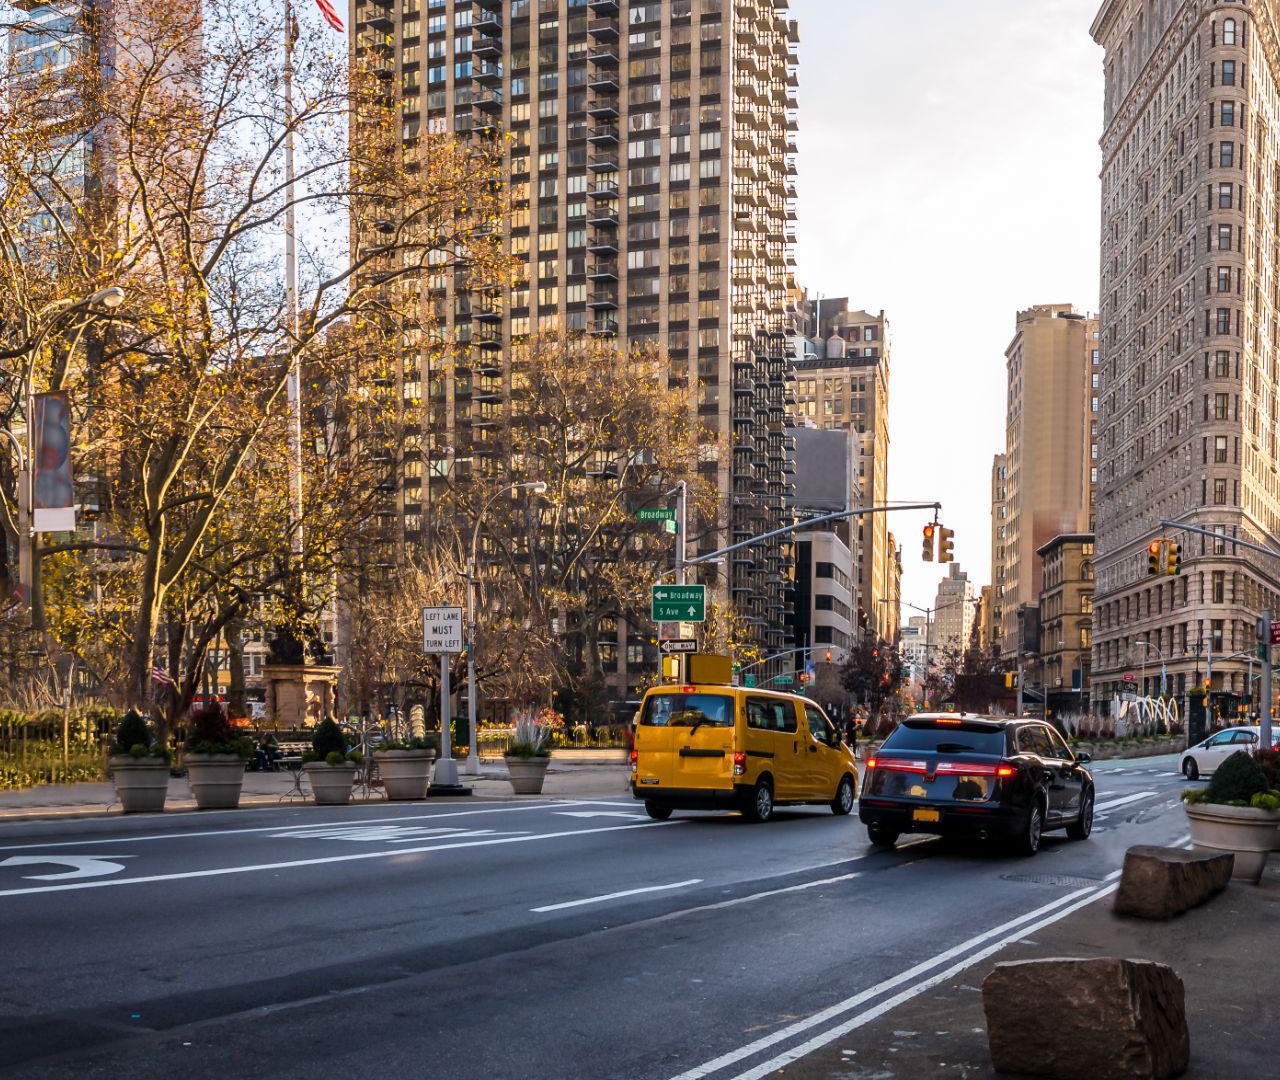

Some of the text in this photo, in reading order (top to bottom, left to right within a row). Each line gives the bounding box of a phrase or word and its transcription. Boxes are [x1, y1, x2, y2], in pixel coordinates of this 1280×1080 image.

[640, 510, 673, 519] Broadway
[670, 591, 703, 601] Broadway
[665, 607, 679, 616] Ave
[425, 612, 460, 621] LEFT LANE
[432, 625, 453, 635] MUST
[426, 640, 460, 648] TURN LEFT
